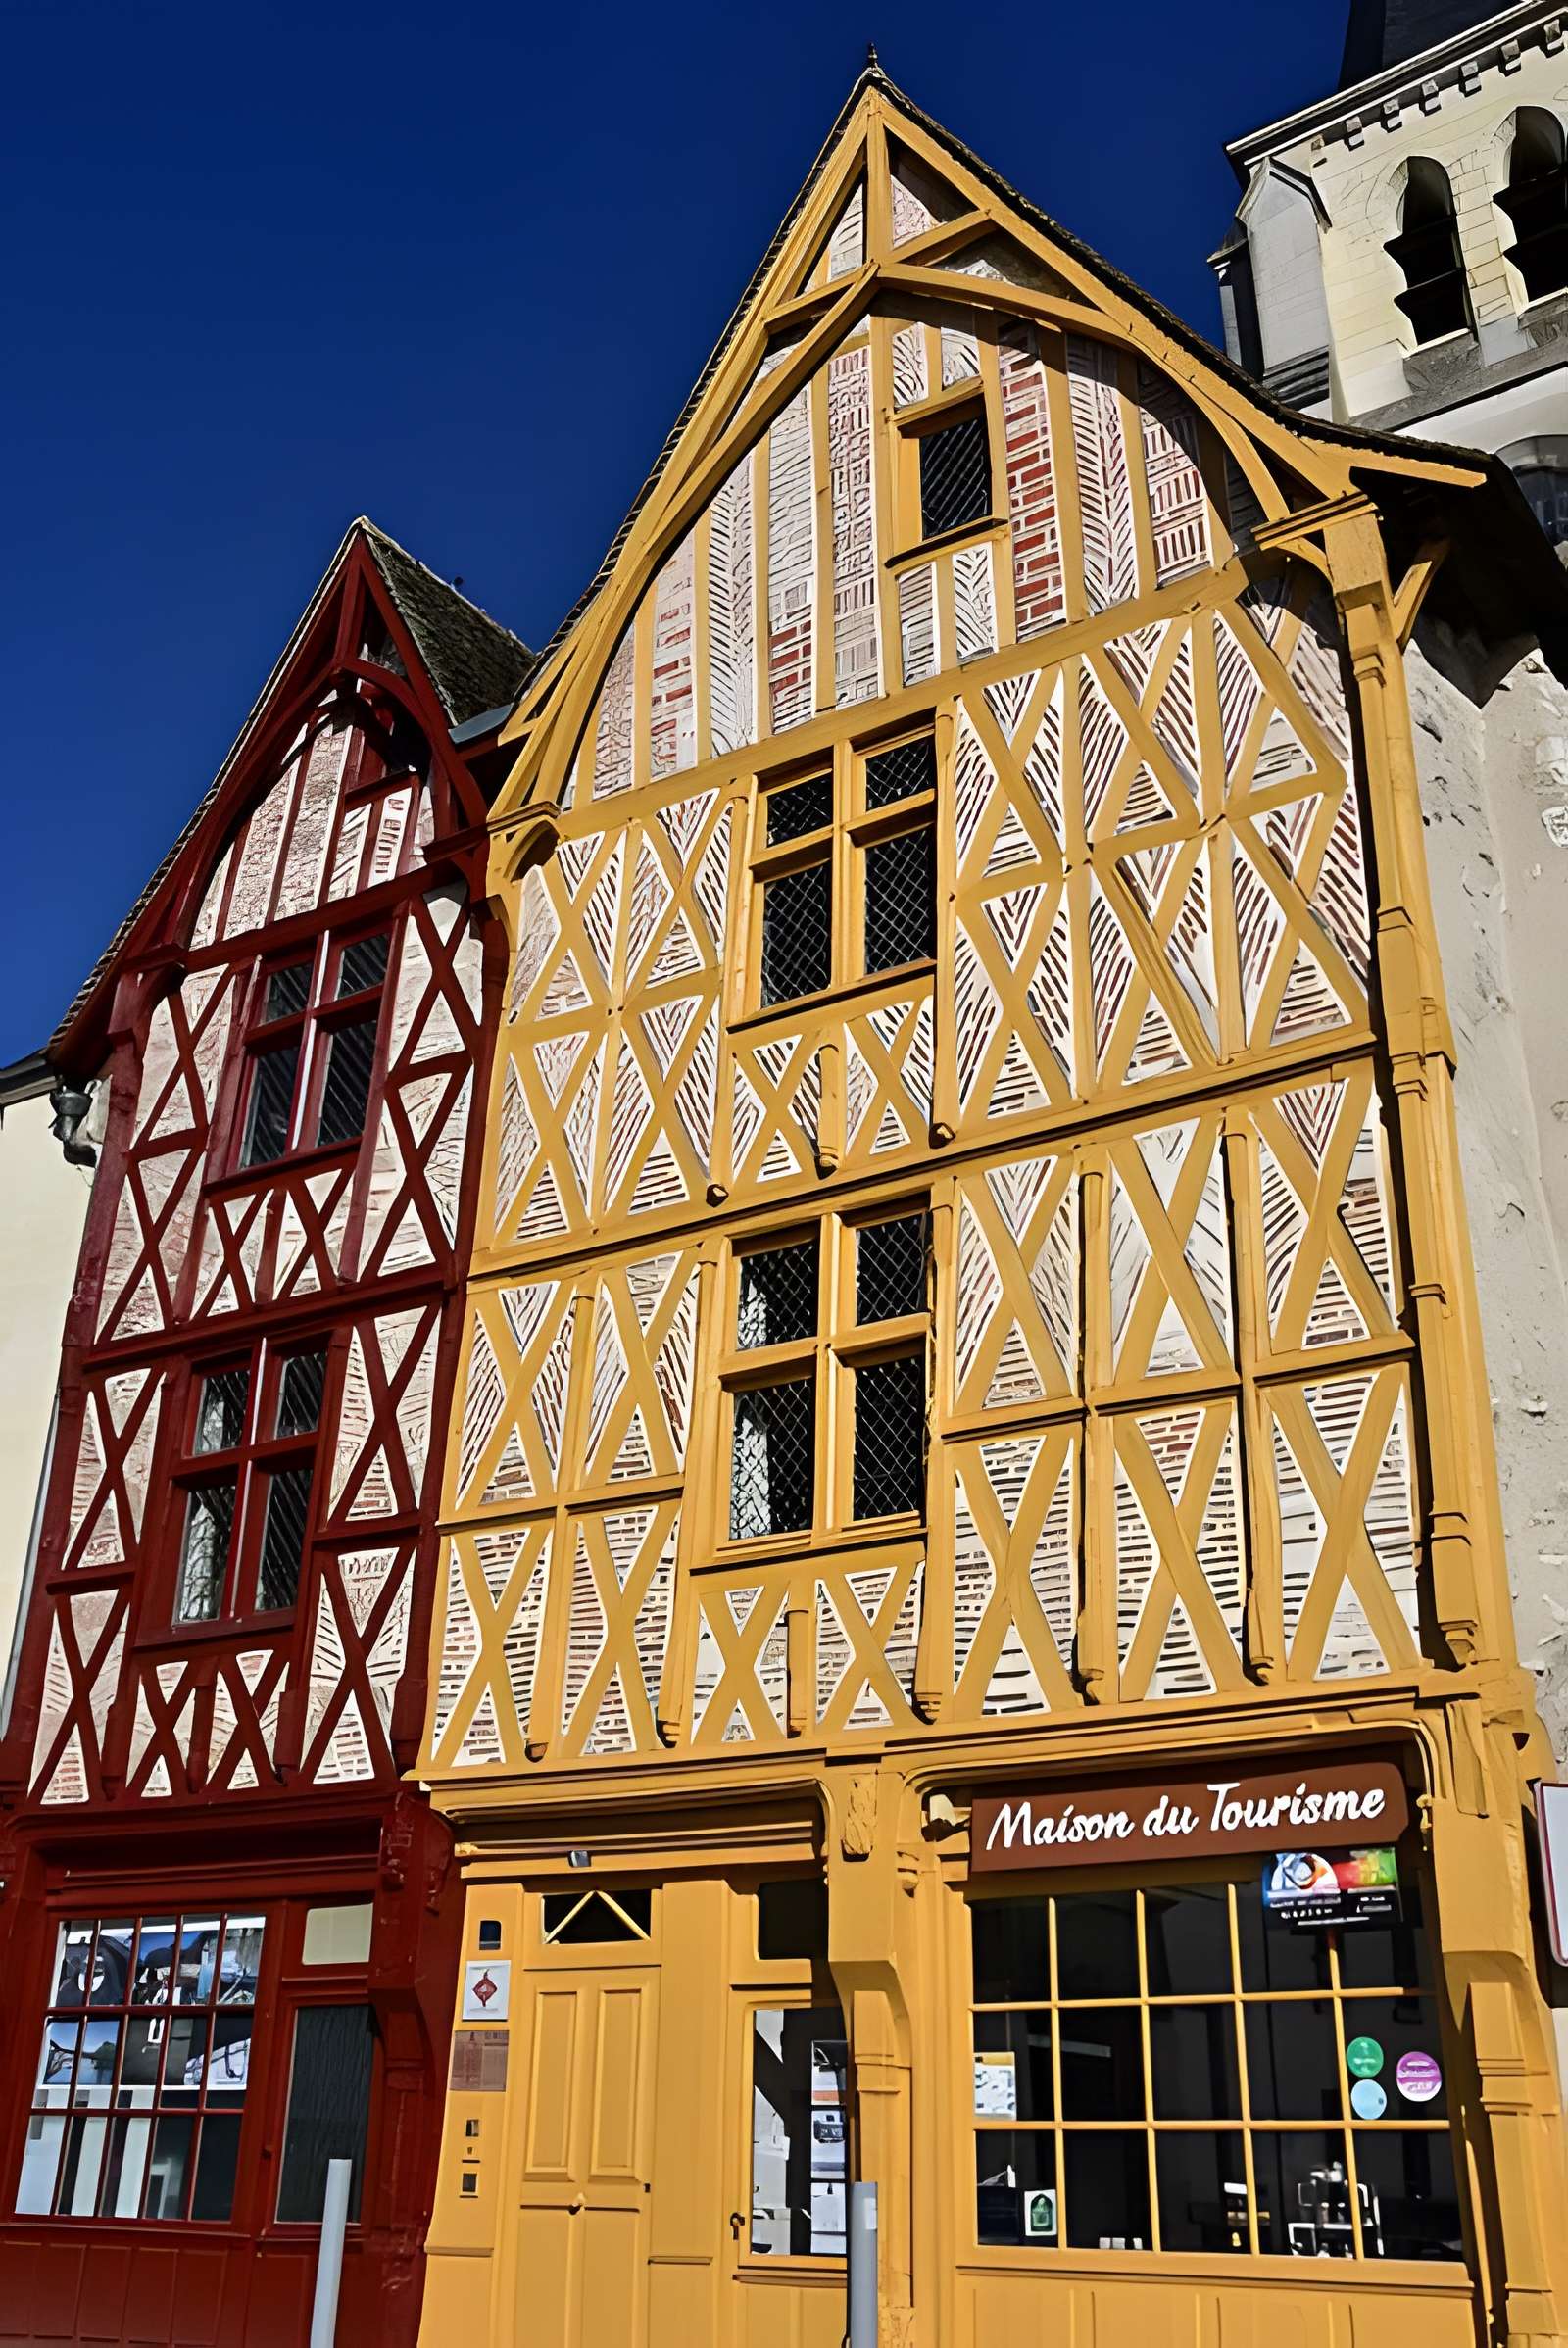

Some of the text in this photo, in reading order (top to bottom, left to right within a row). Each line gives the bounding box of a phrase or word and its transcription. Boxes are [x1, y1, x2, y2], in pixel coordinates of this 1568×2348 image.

[986, 1782, 1386, 1850] Maison du Tourisme
